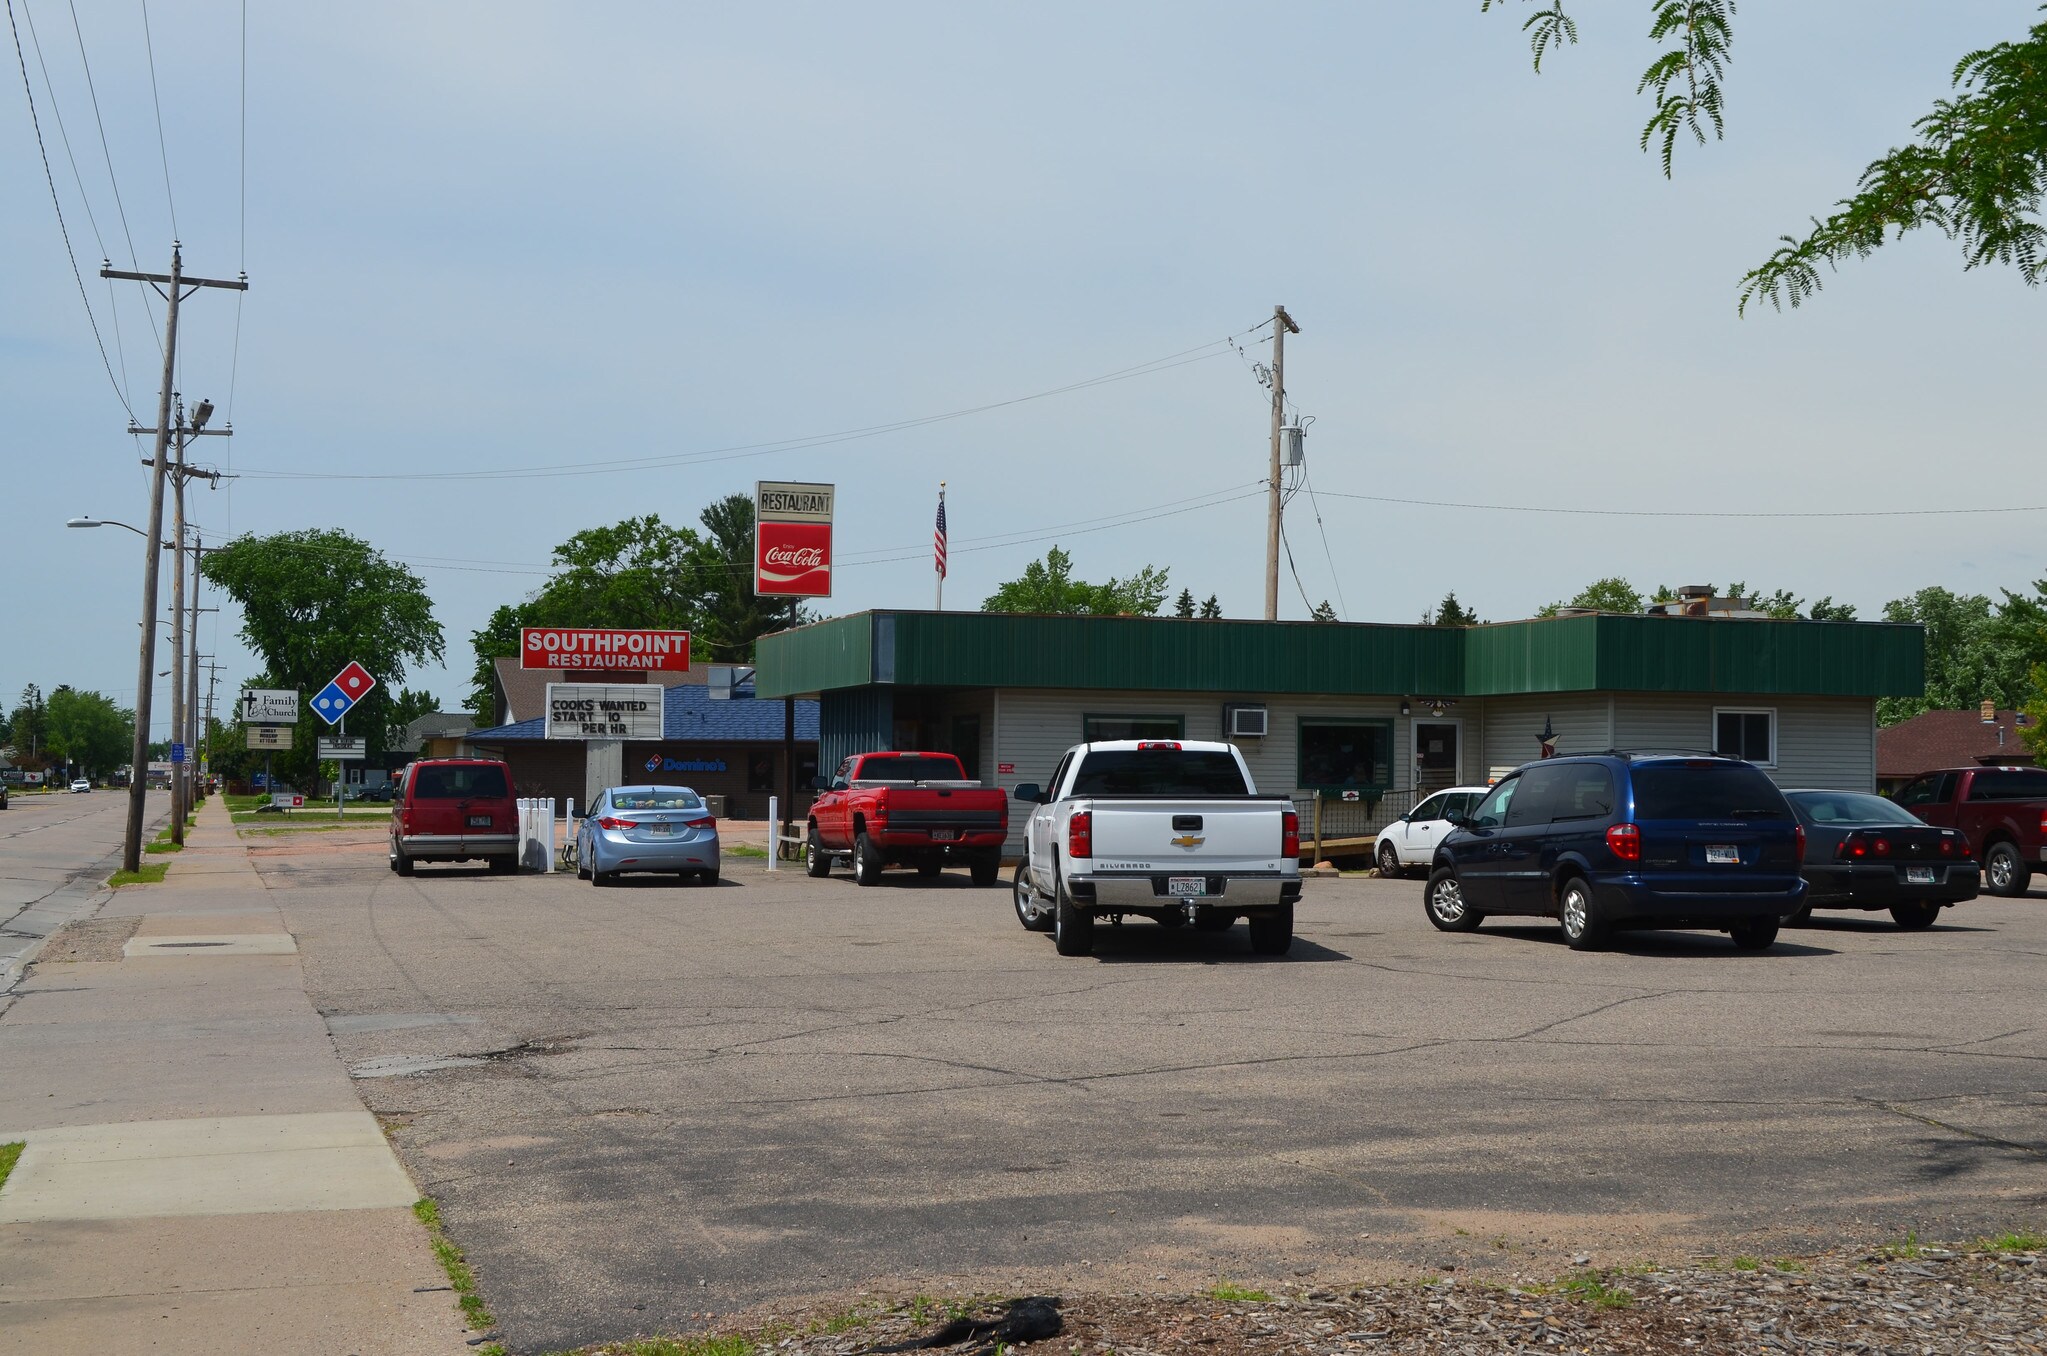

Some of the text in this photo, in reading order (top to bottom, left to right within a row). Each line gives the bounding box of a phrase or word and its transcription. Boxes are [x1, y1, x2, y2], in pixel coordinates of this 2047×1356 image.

[761, 492, 830, 513] RESTAURANT
[765, 546, 824, 567] Coca-Cola
[527, 632, 686, 654] SOUTHPOINT
[548, 653, 665, 668] RESTAURANT
[263, 695, 298, 708] Family
[552, 700, 647, 711] COOKS WANTED
[267, 708, 297, 717] Church
[552, 711, 594, 722] START
[582, 723, 627, 734] PER HR
[663, 757, 727, 772] Domino's
[1176, 882, 1203, 893] LZ8621
